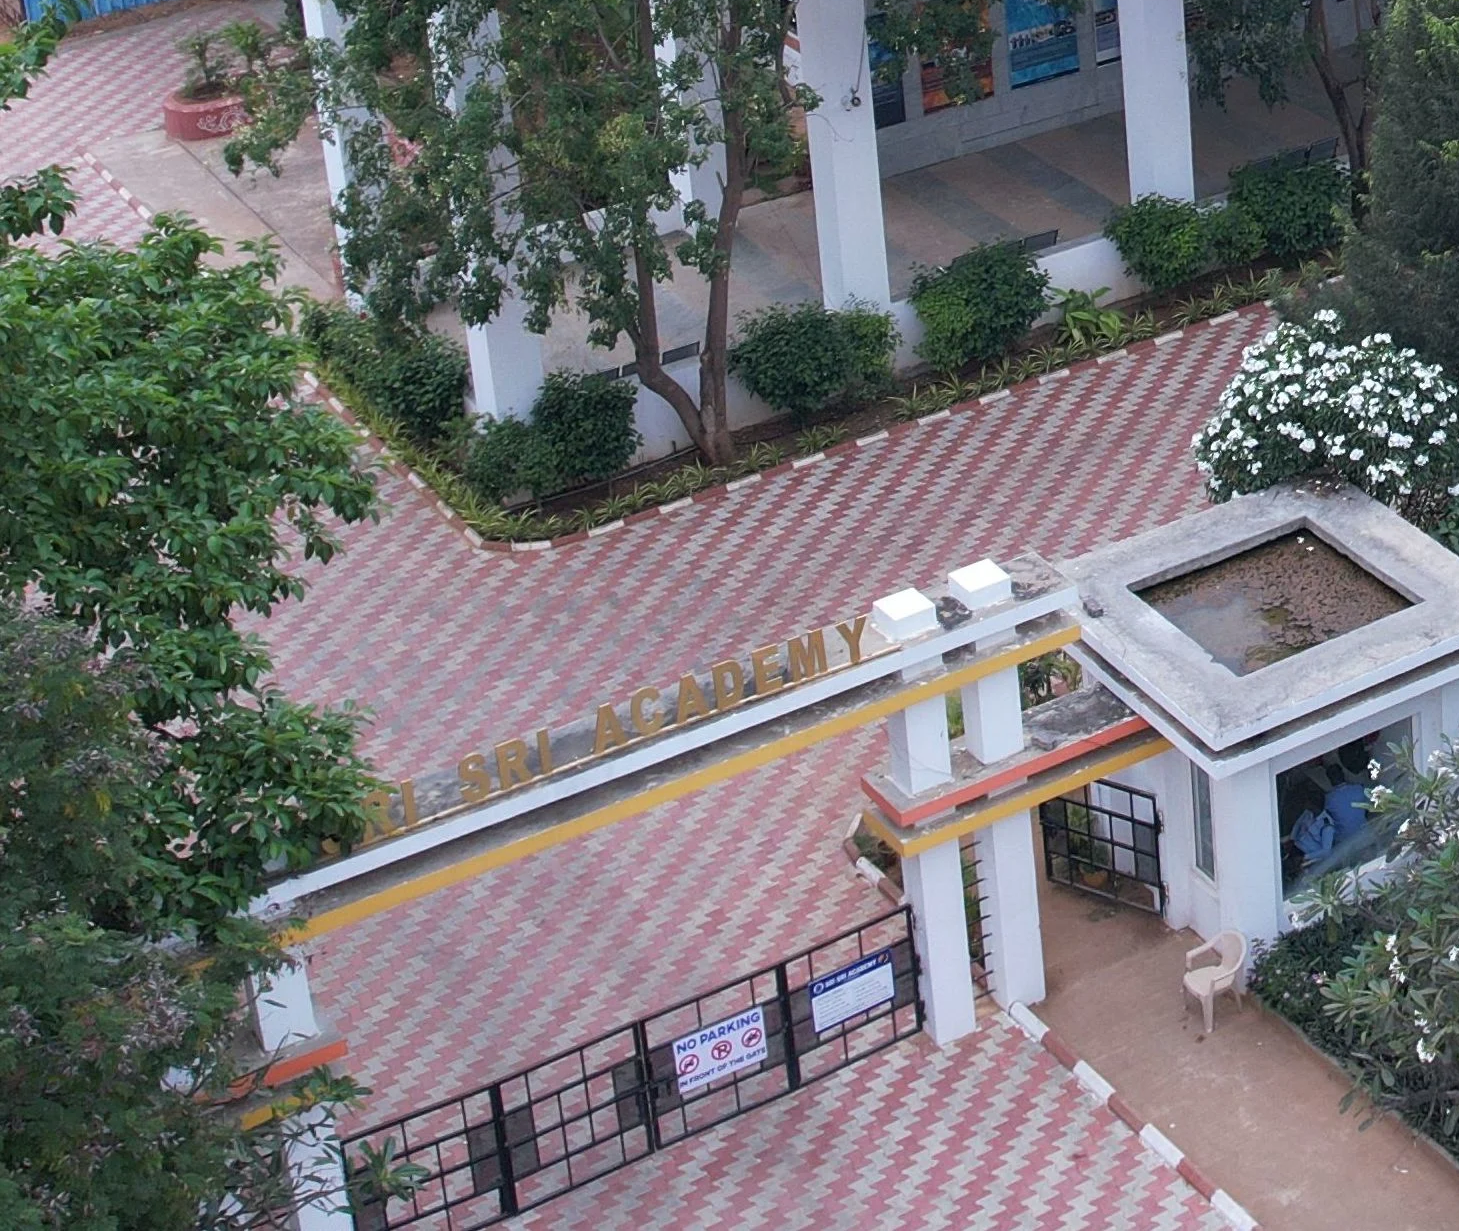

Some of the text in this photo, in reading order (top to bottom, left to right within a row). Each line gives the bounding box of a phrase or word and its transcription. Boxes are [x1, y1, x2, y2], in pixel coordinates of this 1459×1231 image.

[458, 728, 552, 803] SRI
[590, 614, 868, 755] ACADEMY
[676, 1012, 760, 1055] NO PARKING
[689, 1067, 716, 1084] FRONT
[717, 1063, 728, 1072] OF
[729, 1056, 744, 1067] THE
[745, 1046, 766, 1060] GATE
